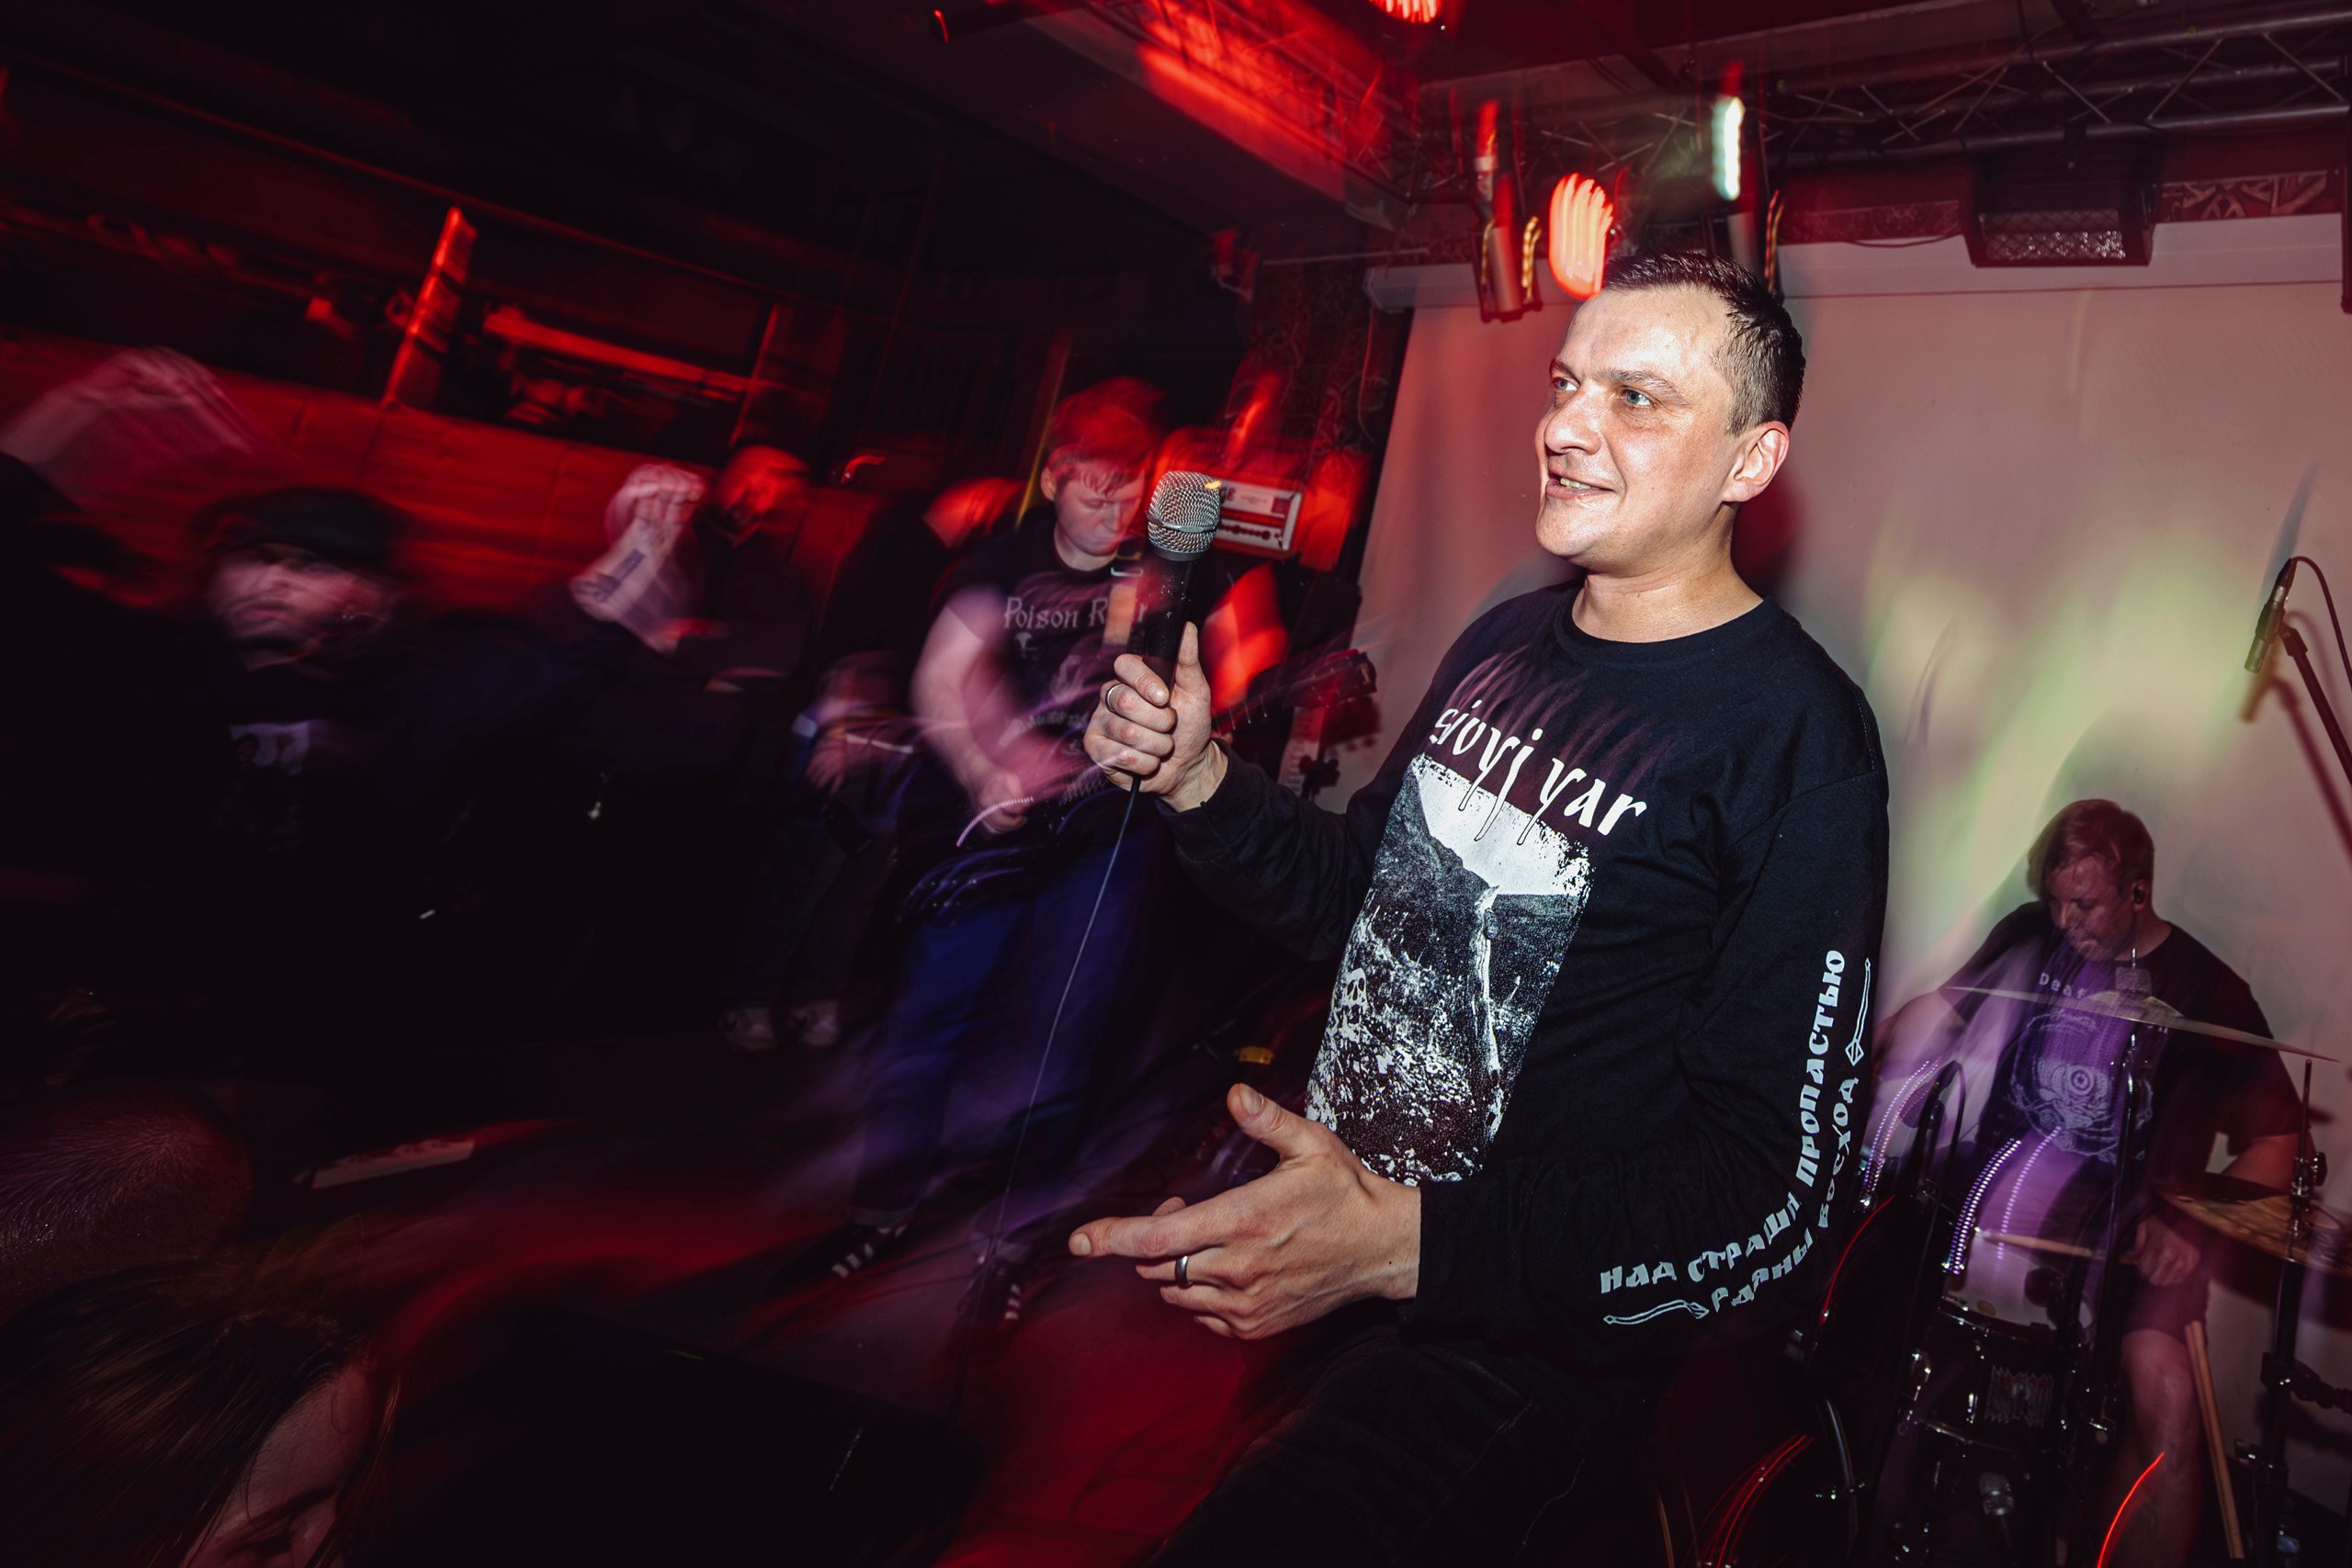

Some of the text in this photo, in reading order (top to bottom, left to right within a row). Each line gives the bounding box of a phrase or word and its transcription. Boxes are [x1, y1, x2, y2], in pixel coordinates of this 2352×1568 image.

[1003, 596, 1079, 629] Poison
[1600, 950, 1846, 1294] НАД СТРАШН ПРОПАСТЬЮ
[1711, 1226, 1814, 1313] РДЯНЫ
